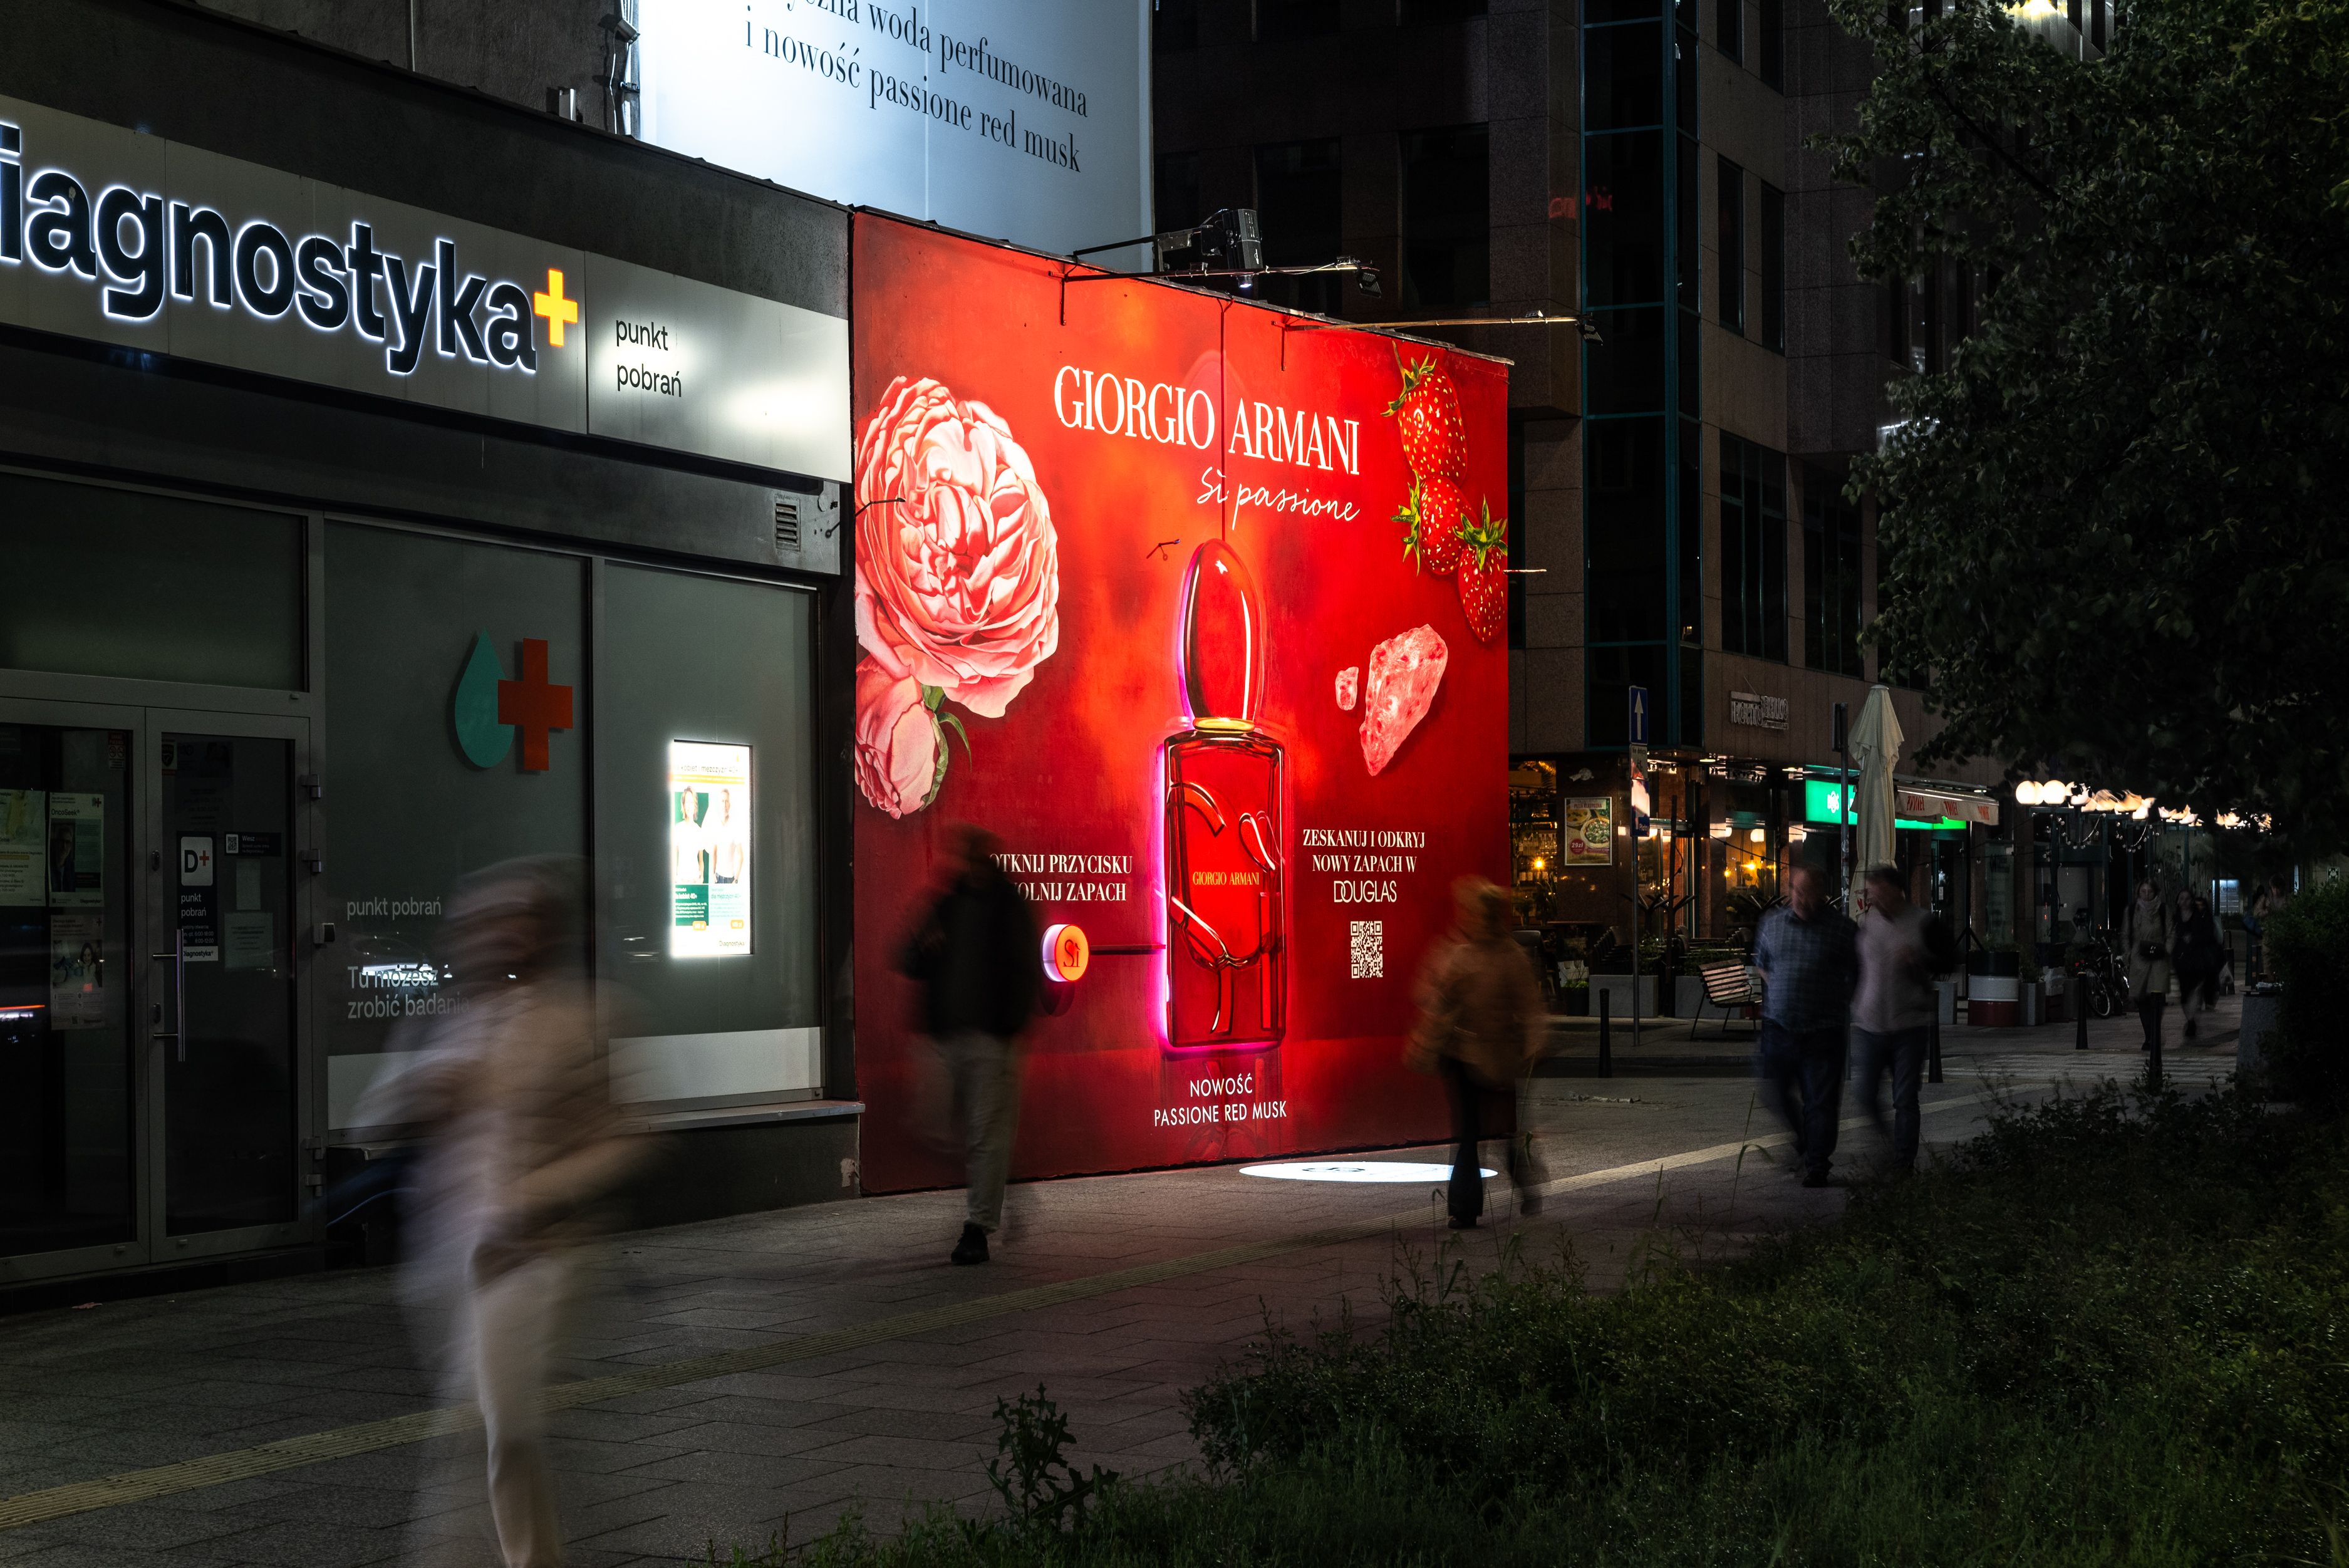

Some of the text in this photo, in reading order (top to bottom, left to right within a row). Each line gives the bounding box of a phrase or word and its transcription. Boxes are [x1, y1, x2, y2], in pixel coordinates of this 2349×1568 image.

[868, 4, 932, 53] woda
[940, 33, 1088, 118] perfumowana
[745, 5, 1081, 174] i nowość passione red musk
[616, 318, 668, 352] punkt
[616, 362, 682, 398] pobrań
[1054, 365, 1361, 475] GIORGIO ARMANI
[1232, 483, 1361, 531] passione
[1302, 829, 1426, 849] ZESKANUJ I ODKRYJ
[1049, 854, 1133, 874] PRZYCISKU
[1312, 854, 1418, 873] NOWY ZAPACH W
[1192, 871, 1260, 886] GIORGIO ARMANI
[180, 893, 202, 905] punkt
[1066, 883, 1127, 901] ZAPACH
[1333, 880, 1397, 903] DOUGLAS
[180, 907, 206, 918] pobrań
[346, 896, 442, 921] punkt pobrań
[346, 965, 369, 989] Tu
[347, 994, 400, 1019] zrobić
[1190, 1072, 1253, 1098] NOWOŚĆ
[1154, 1100, 1287, 1127] PASSIONE RED MUSK
